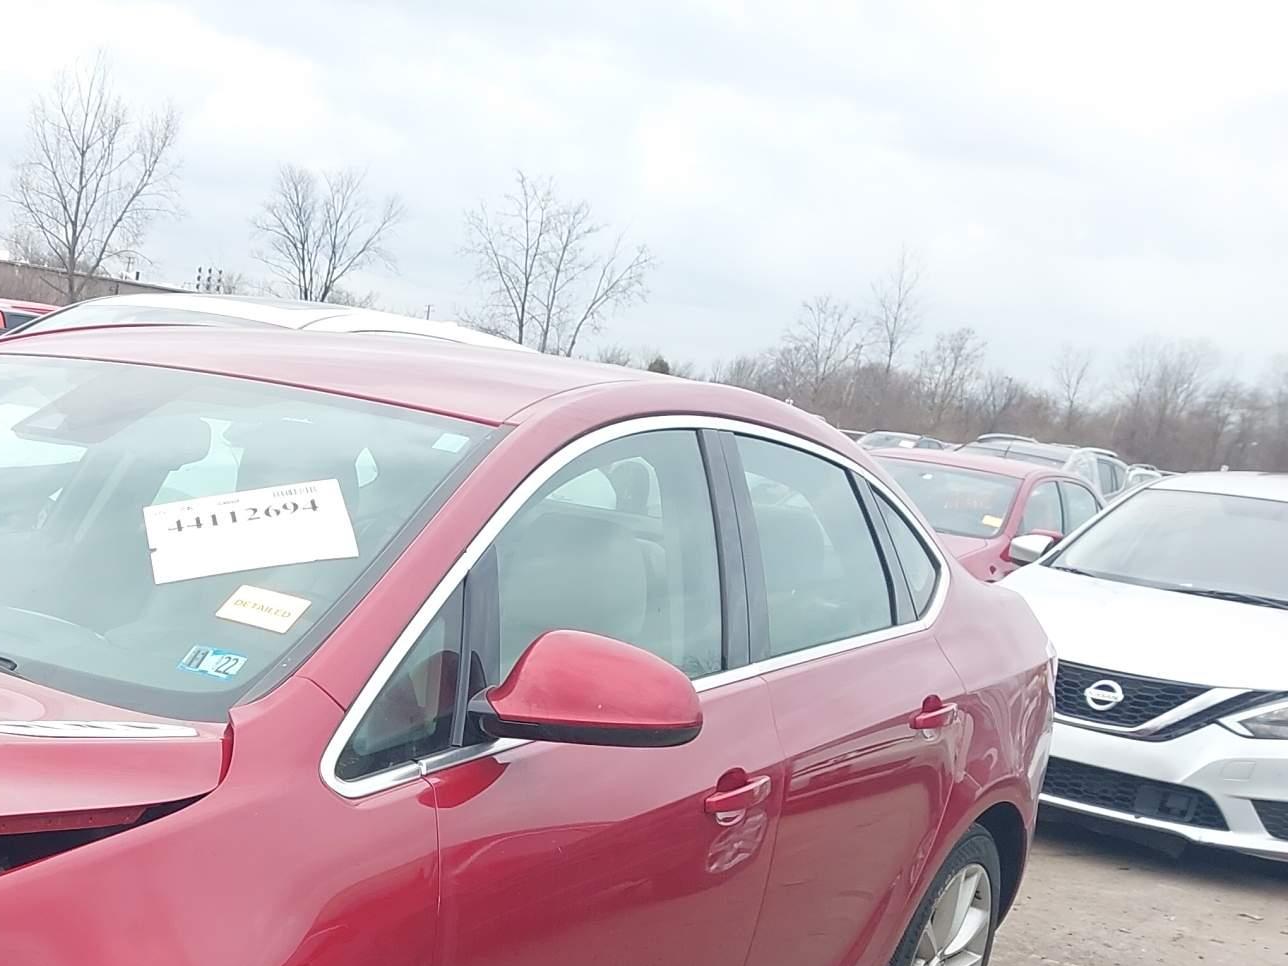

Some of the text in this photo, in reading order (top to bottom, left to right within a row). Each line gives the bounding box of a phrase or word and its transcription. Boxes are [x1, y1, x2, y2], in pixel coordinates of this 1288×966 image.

[168, 499, 320, 533] 44112694
[232, 599, 292, 619] DETAILED
[215, 656, 240, 675] 22
